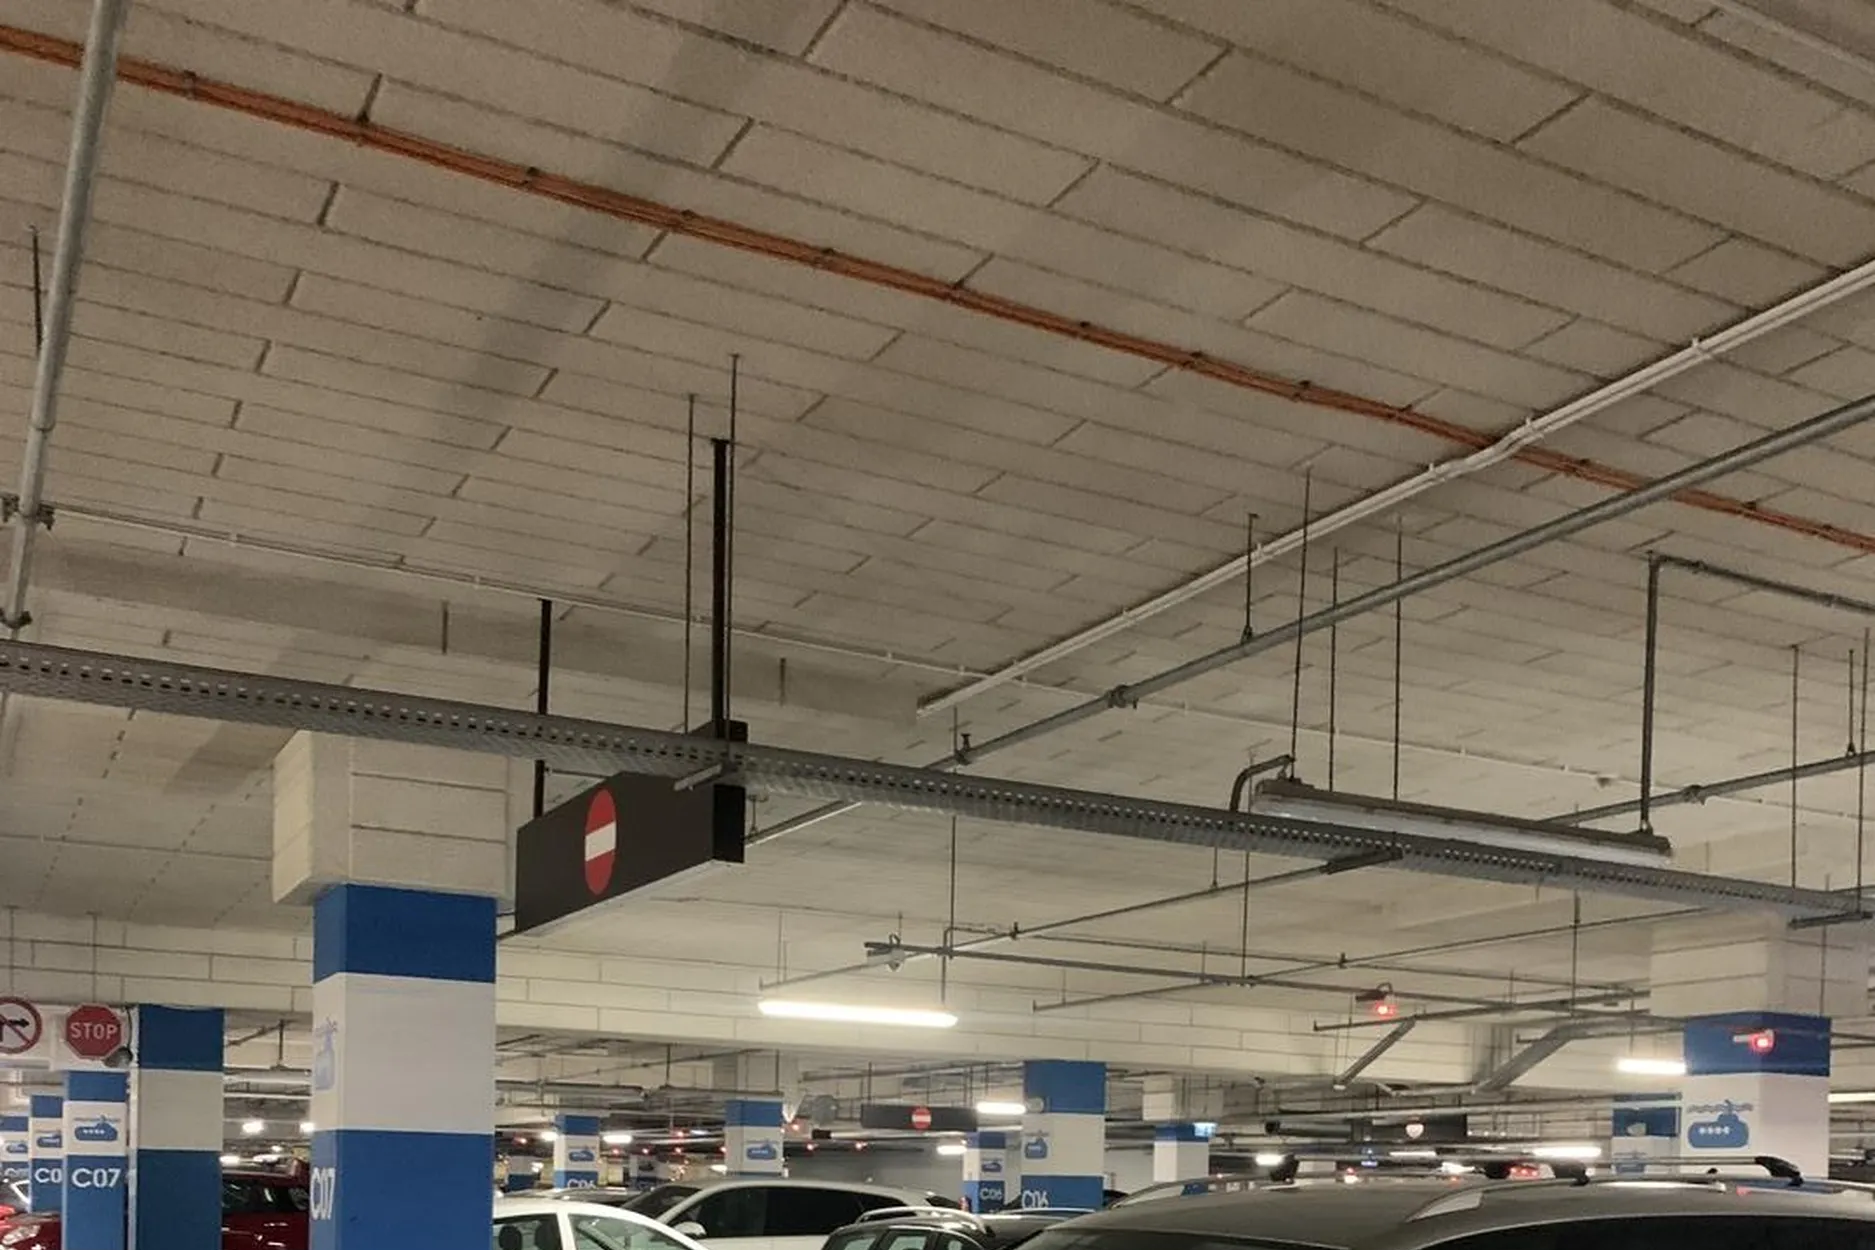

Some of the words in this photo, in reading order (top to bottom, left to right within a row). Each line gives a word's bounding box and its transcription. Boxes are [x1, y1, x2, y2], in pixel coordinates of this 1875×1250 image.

[70, 1022, 118, 1040] STOP
[71, 1167, 121, 1188] C07
[310, 1167, 336, 1220] C07
